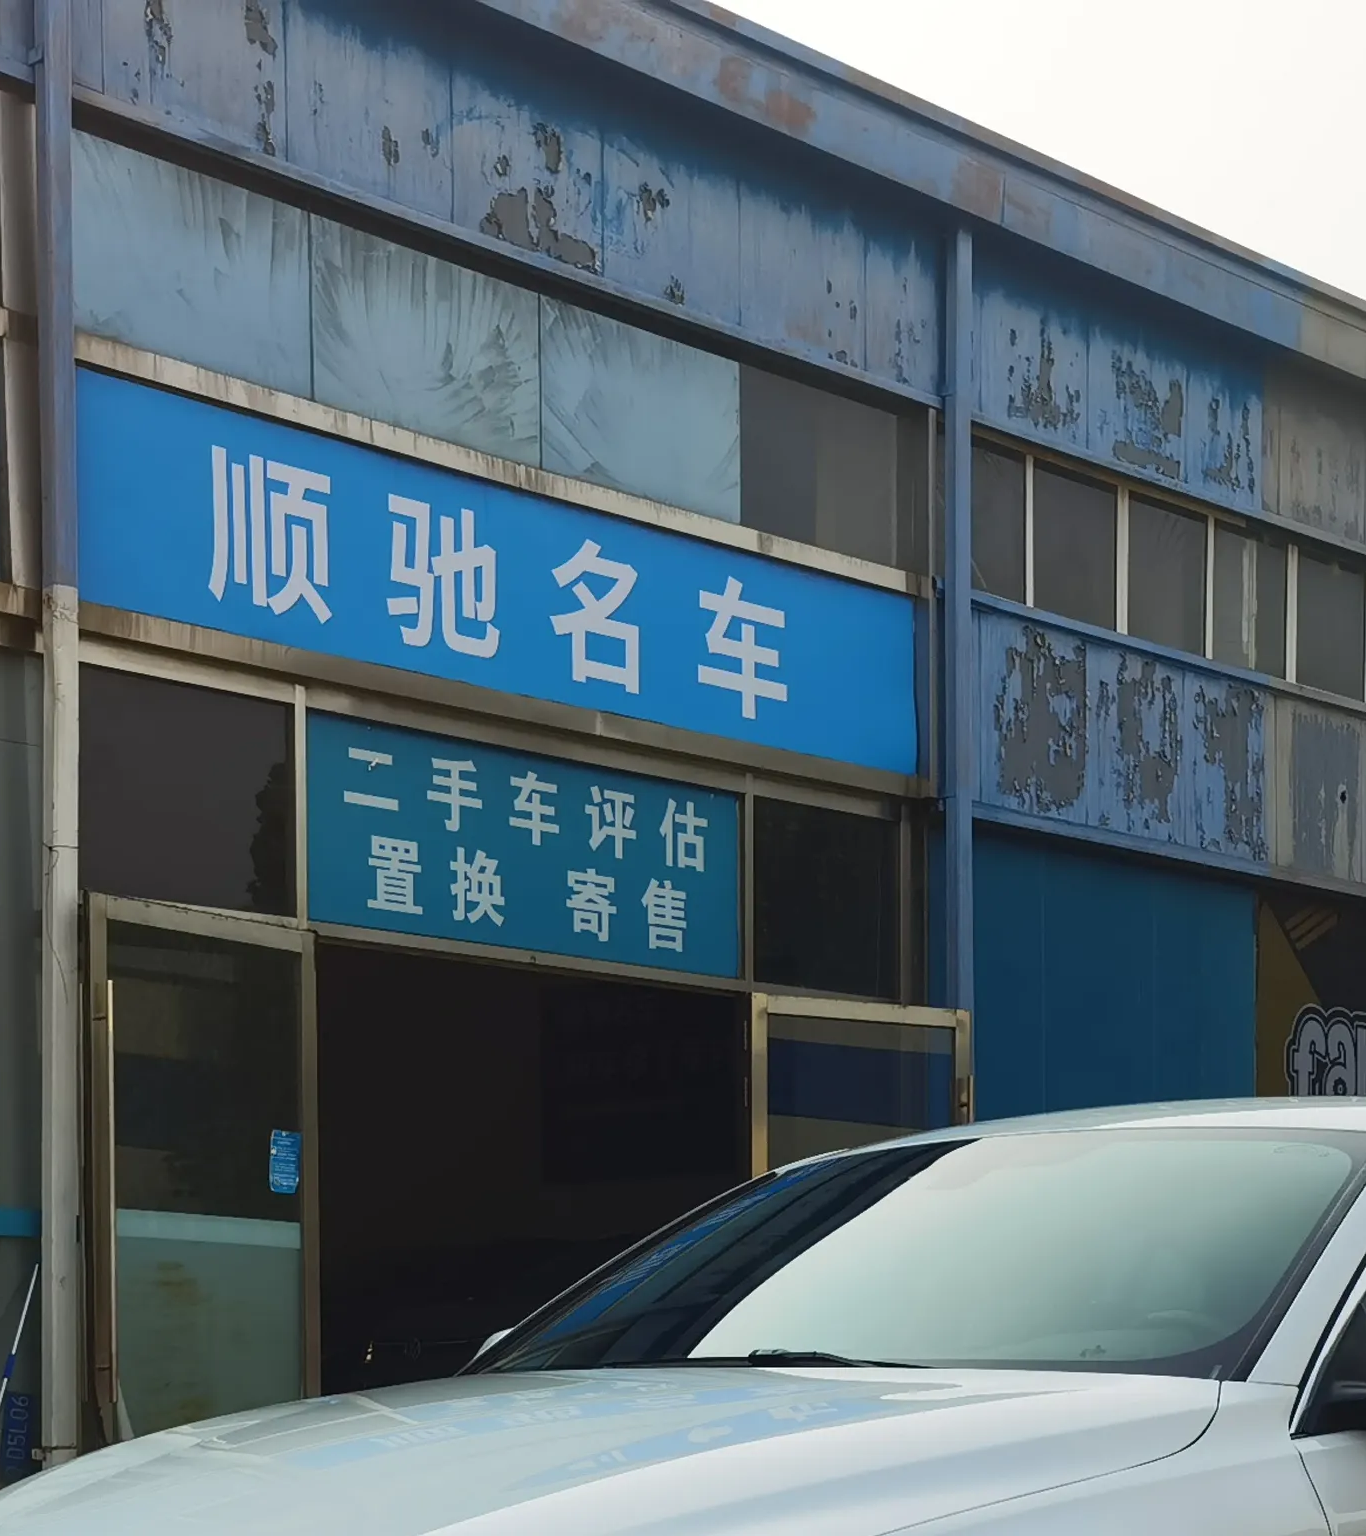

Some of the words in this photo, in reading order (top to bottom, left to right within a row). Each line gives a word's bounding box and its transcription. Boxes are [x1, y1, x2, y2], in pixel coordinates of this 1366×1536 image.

[208, 445, 788, 720] 顺驰名车
[343, 746, 709, 872] 二手车评估
[367, 836, 505, 928] 置换
[565, 868, 689, 953] 寄售
